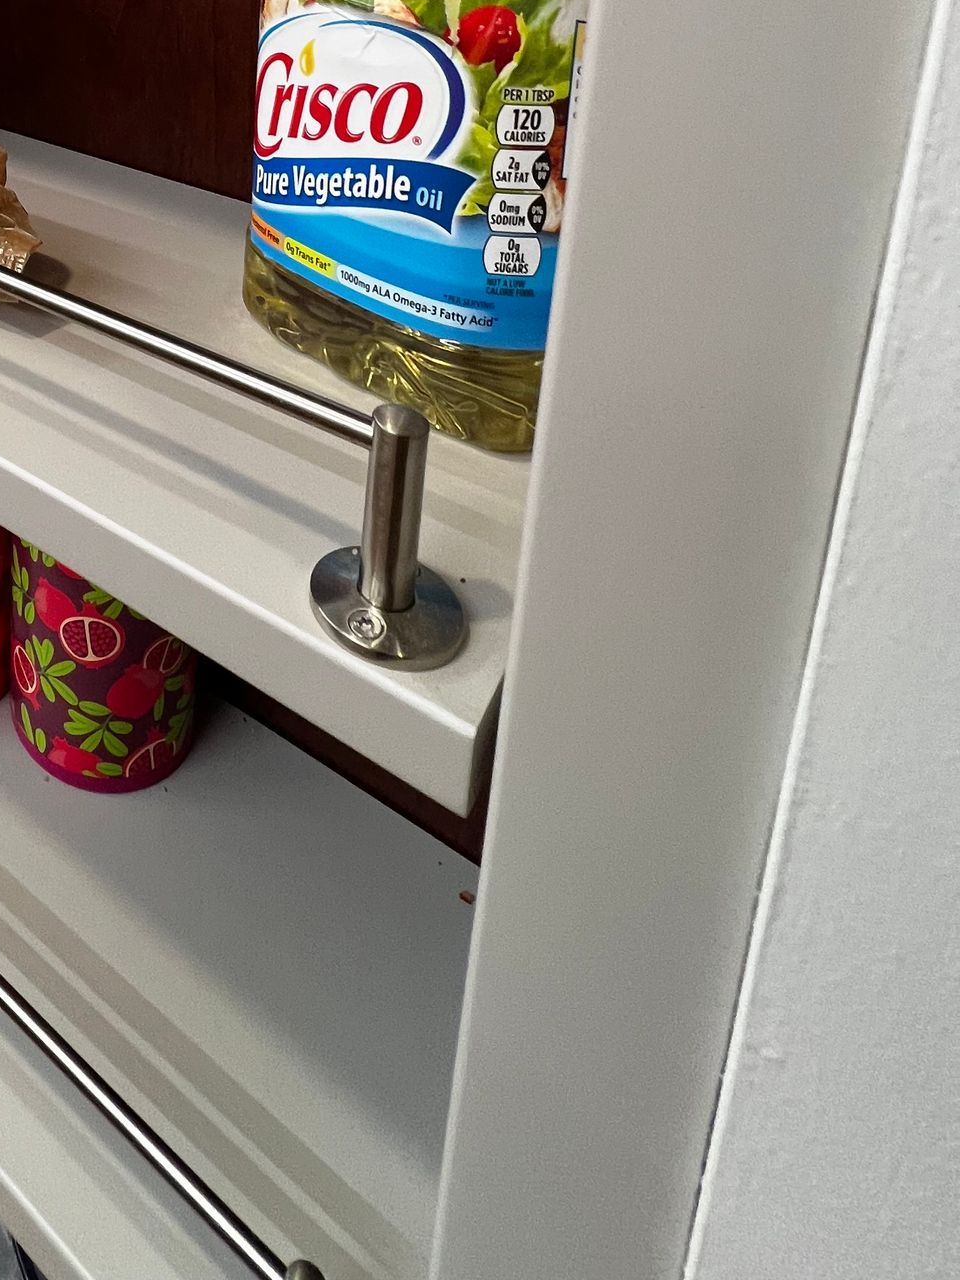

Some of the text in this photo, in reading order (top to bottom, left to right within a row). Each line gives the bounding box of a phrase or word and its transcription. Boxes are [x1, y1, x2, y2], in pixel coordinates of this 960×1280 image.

[504, 88, 523, 101] PER
[532, 89, 555, 102] TBSP
[513, 109, 542, 131] 120
[504, 130, 546, 142] CALORIES
[508, 156, 521, 171] 2g
[495, 170, 512, 182] SAT
[514, 172, 530, 183] FAT
[256, 164, 444, 211] Pure Vegetable Oil
[499, 200, 521, 214] 0mg
[490, 214, 526, 226] SODIUM
[267, 230, 280, 244] Free
[285, 241, 295, 255] 0g
[295, 247, 314, 264] Trans
[507, 239, 520, 252] 0g
[500, 251, 525, 263] TOTAL
[494, 262, 529, 274] SUGARS
[341, 269, 371, 293] 1000mg
[371, 284, 391, 300] ALA
[392, 292, 437, 316] Omega-3
[440, 306, 467, 326] Fatty
